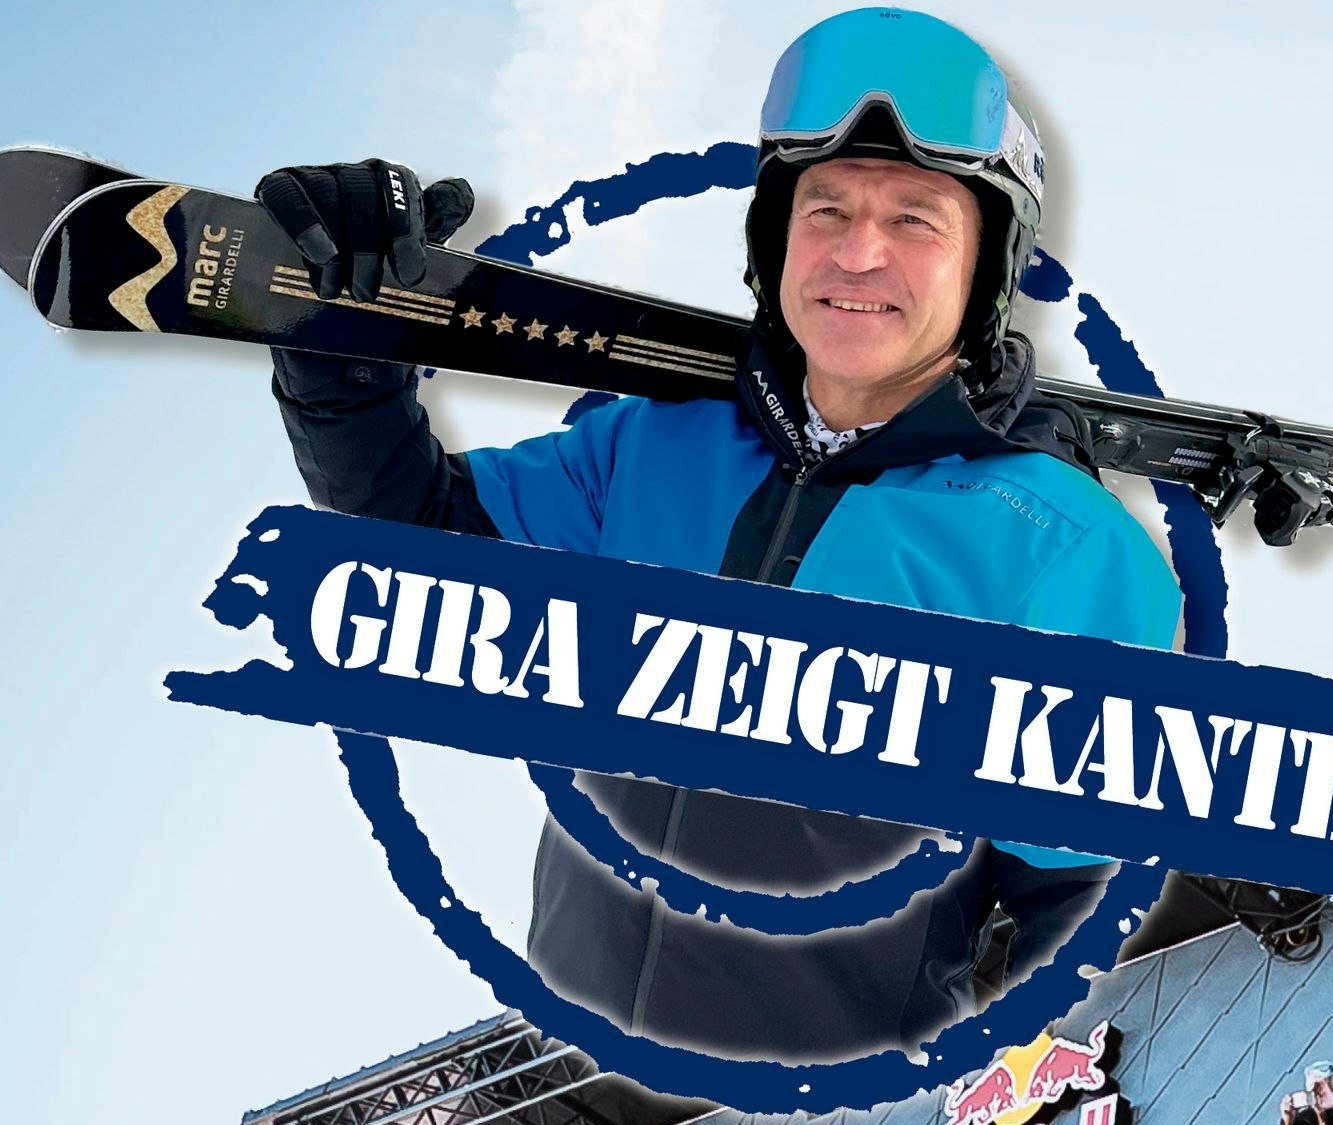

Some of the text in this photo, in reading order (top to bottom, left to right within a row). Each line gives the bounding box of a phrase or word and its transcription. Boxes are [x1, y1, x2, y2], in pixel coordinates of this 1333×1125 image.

[388, 168, 408, 211] LEKI
[186, 223, 227, 307] marc
[214, 228, 245, 310] GIRARDELLI
